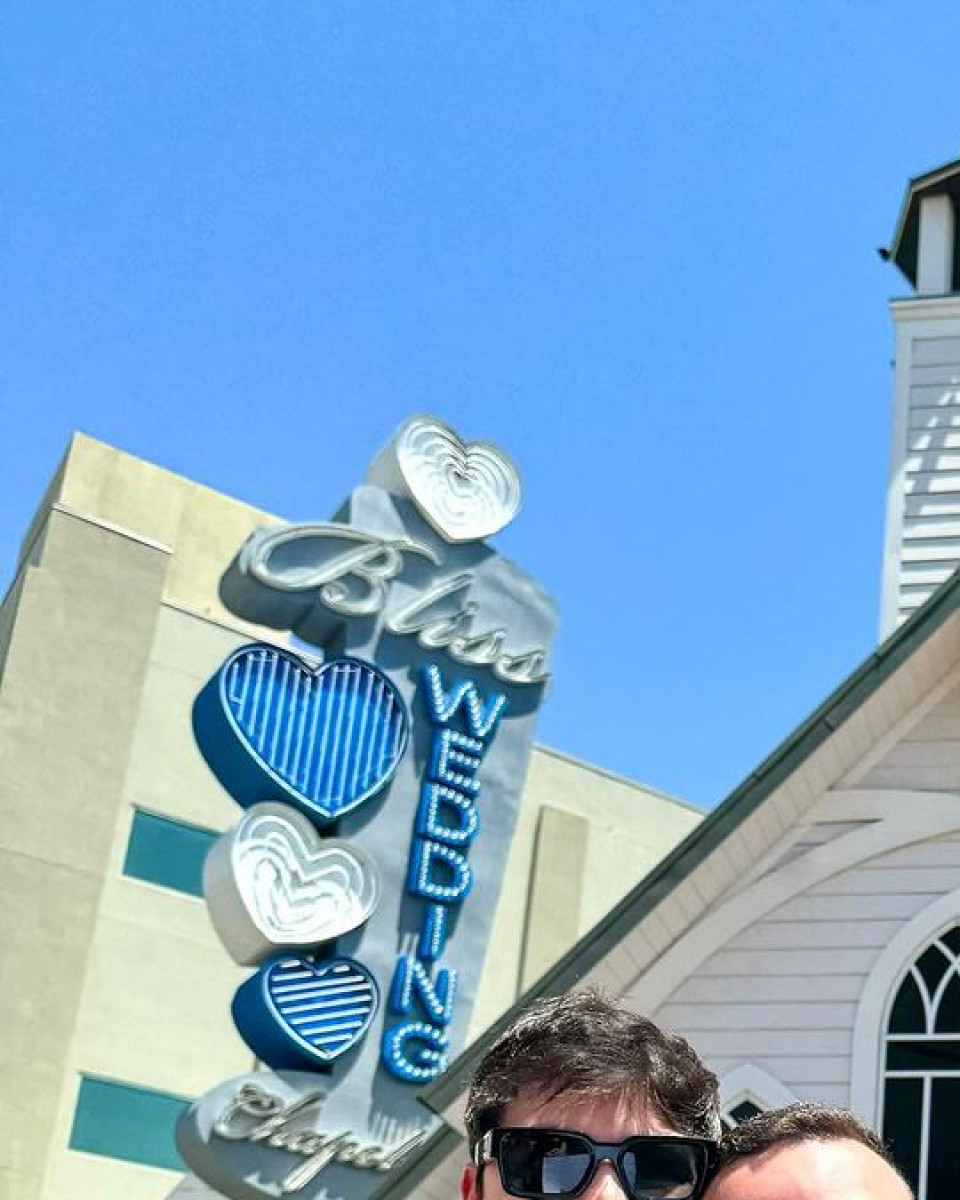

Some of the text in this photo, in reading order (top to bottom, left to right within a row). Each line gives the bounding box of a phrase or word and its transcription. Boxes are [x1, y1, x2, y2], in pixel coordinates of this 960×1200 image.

[249, 520, 551, 684] Bliss
[381, 662, 507, 1084] WEDDING
[213, 1083, 426, 1193] Chapel
